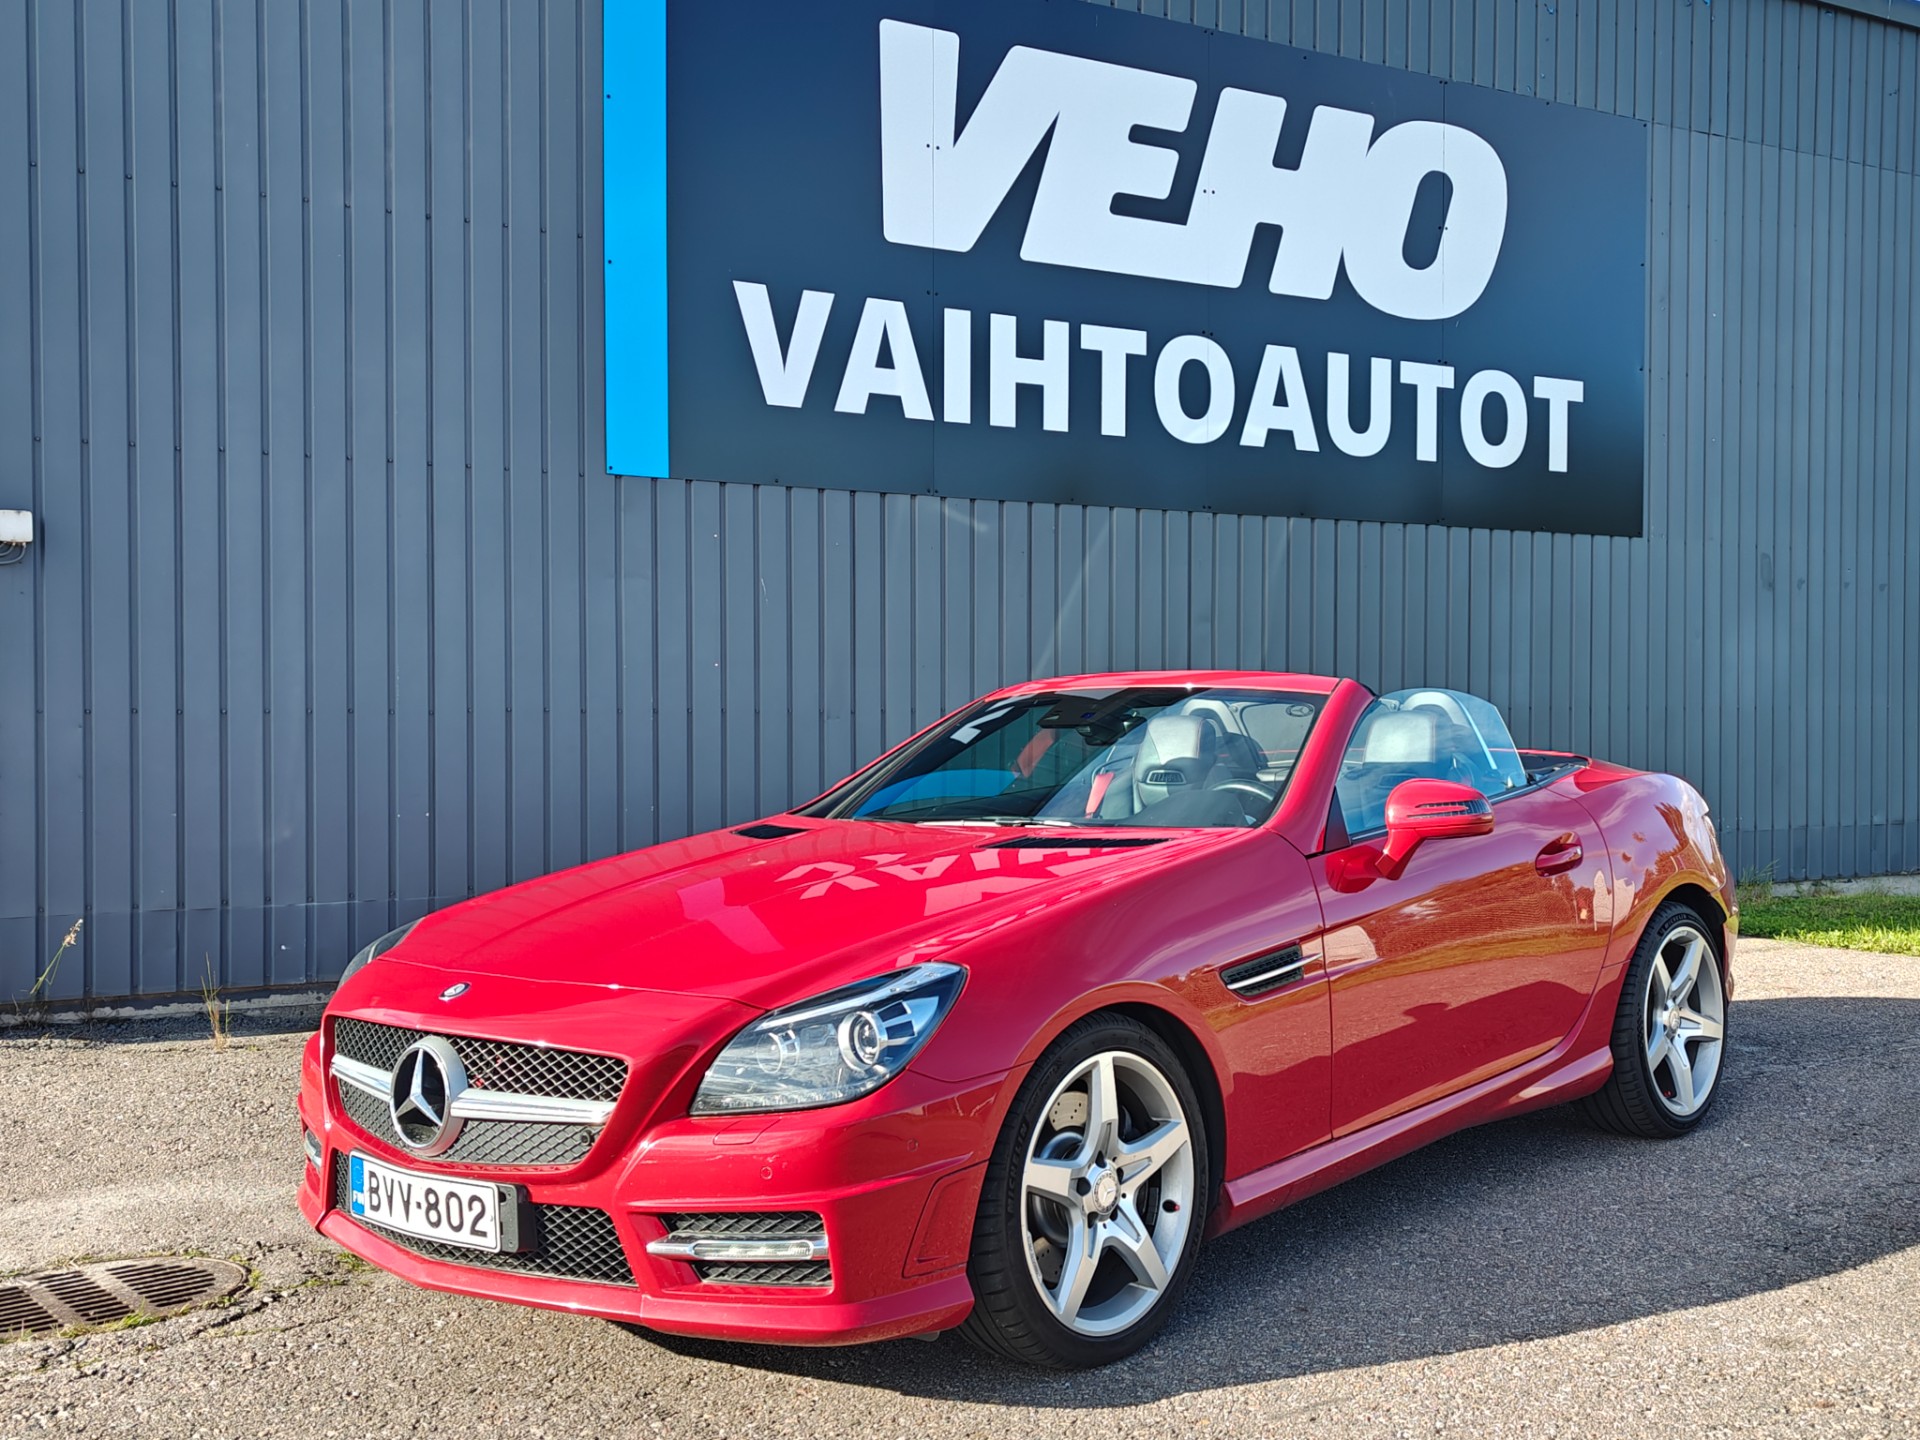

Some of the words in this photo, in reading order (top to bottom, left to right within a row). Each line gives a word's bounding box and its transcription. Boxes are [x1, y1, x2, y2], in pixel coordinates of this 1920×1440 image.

[878, 18, 1508, 321] VEHO
[732, 279, 1585, 474] VAIHTOAUTOT
[367, 1169, 488, 1239] BVV-802
